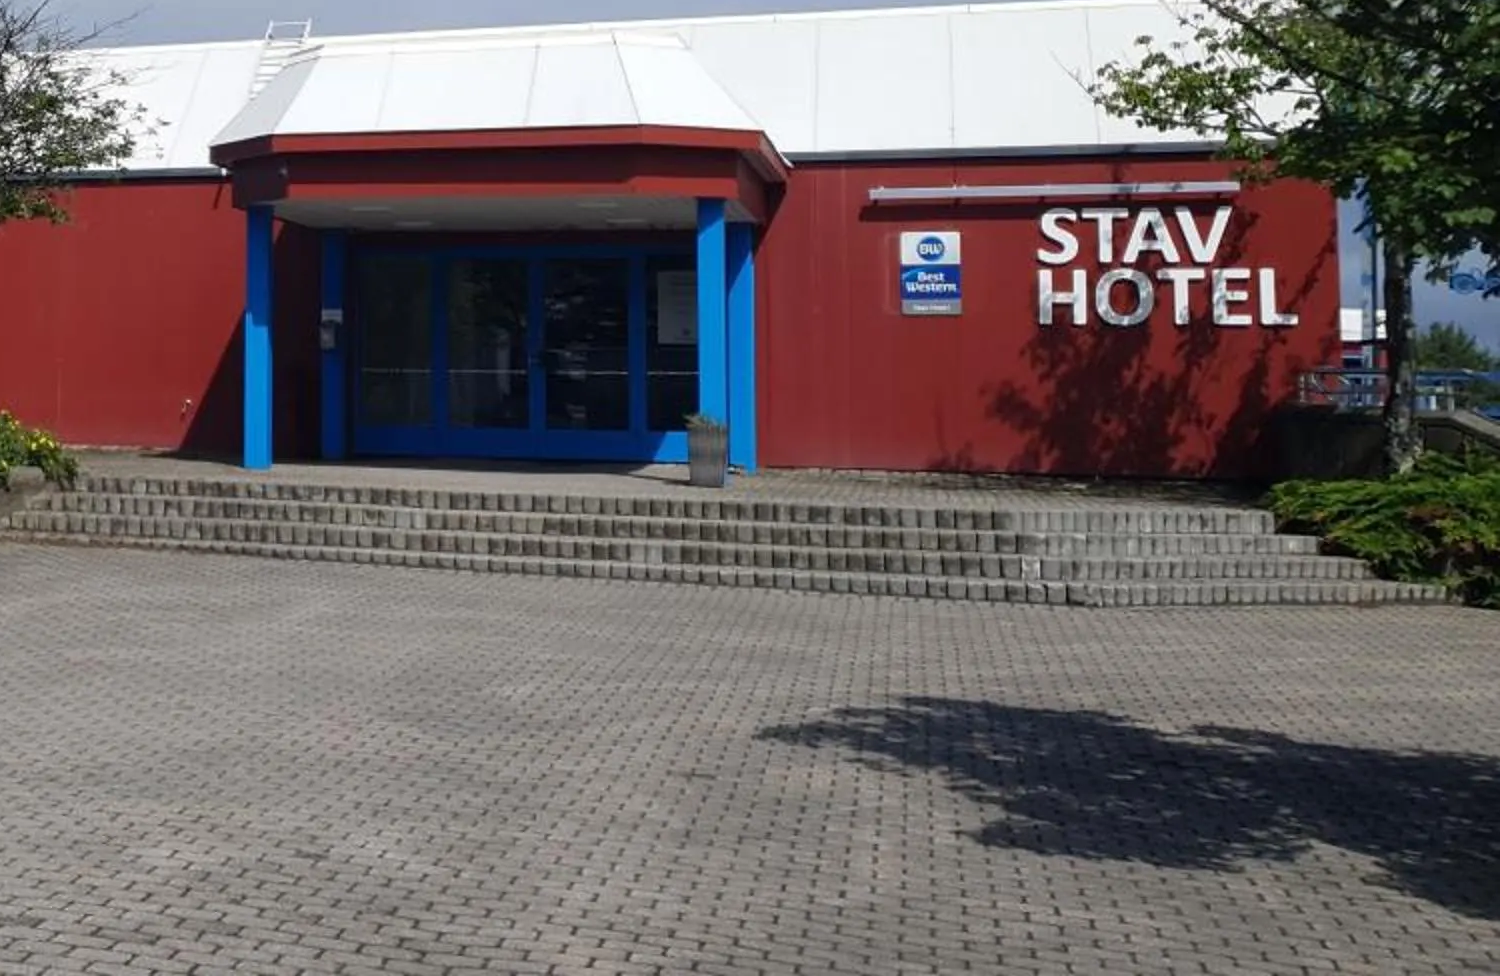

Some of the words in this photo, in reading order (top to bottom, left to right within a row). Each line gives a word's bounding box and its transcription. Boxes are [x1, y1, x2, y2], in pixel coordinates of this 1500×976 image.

[1036, 206, 1234, 265] STAV
[905, 282, 957, 293] Western
[917, 271, 946, 282] Best
[1037, 267, 1299, 326] HOTEL
